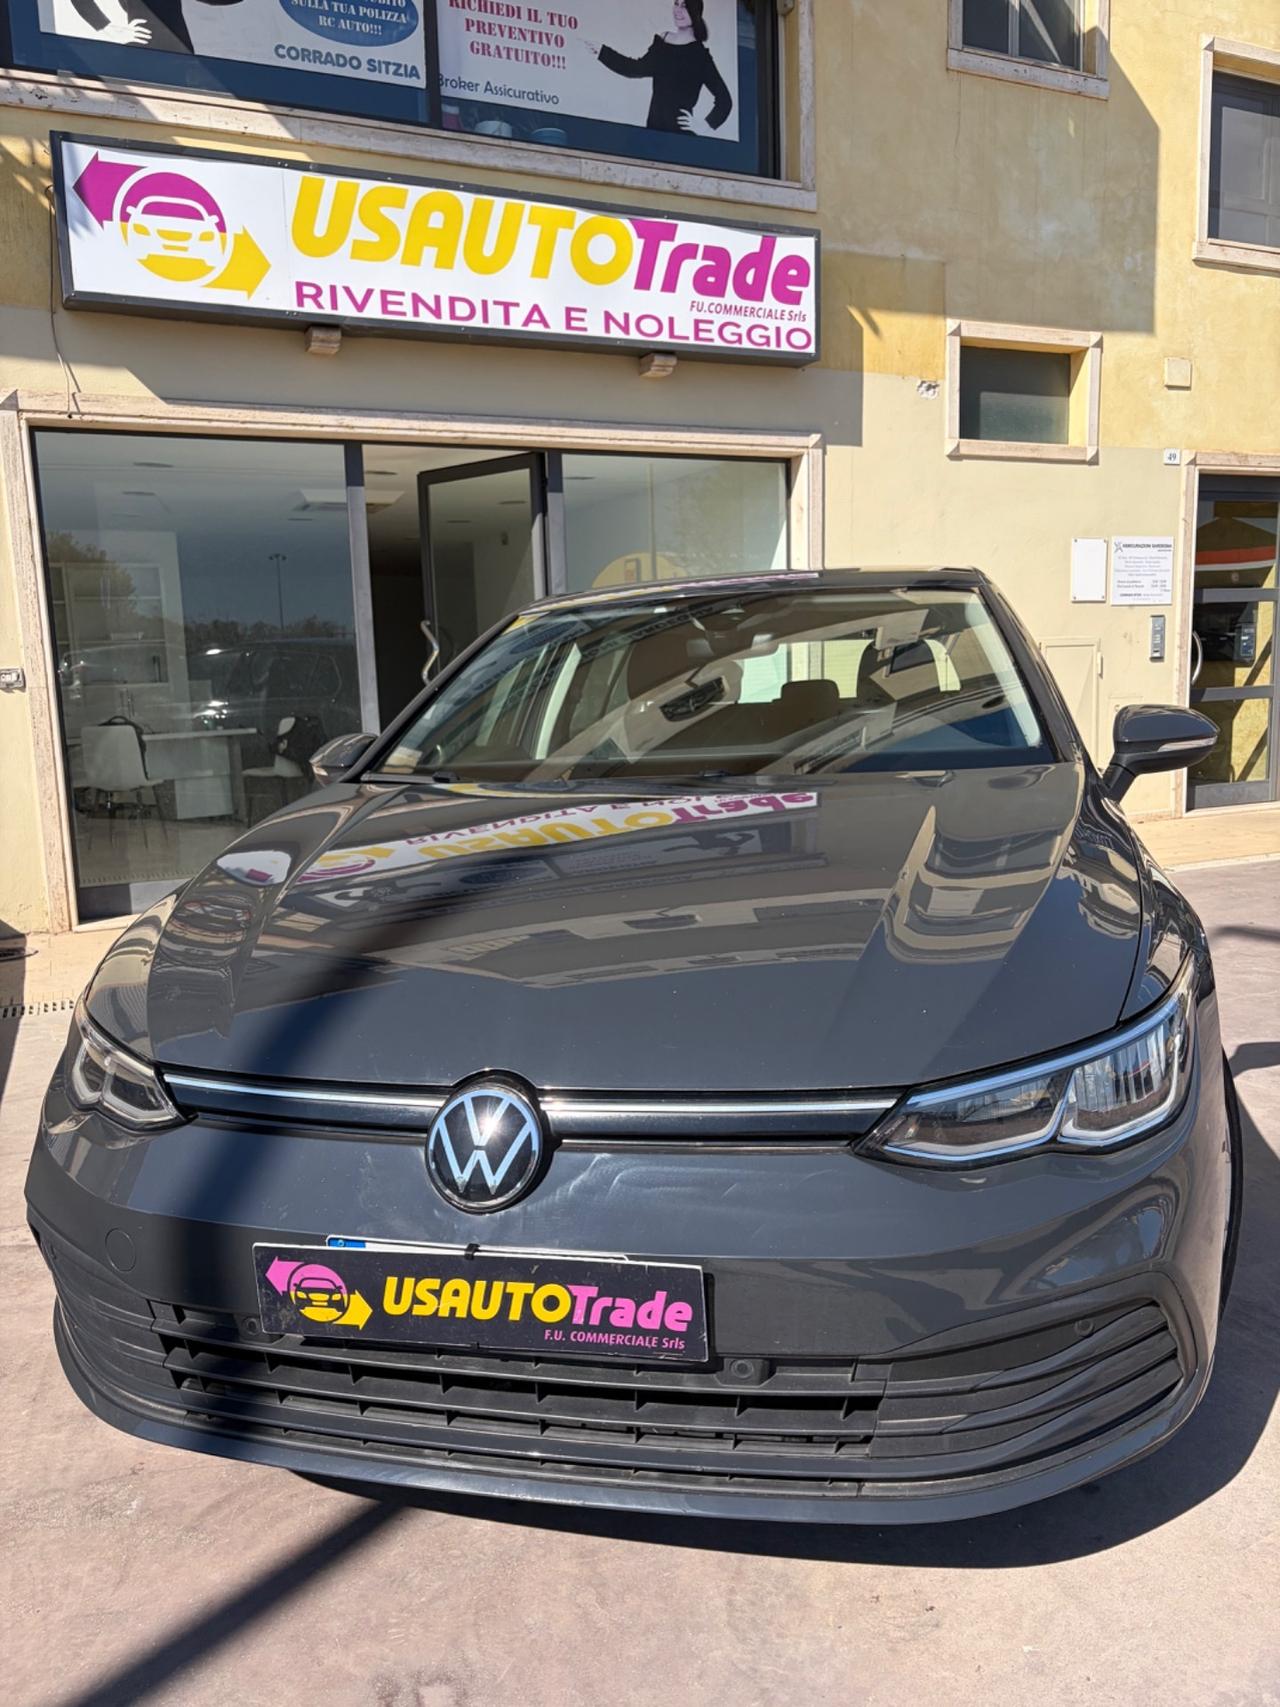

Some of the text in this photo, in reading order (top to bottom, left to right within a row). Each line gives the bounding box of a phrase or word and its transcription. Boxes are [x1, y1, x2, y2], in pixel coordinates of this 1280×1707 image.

[319, 15, 382, 36] RC AUTO!!!
[331, 2, 356, 16] TUA
[359, 6, 407, 24] POLIZZA
[449, 0, 578, 30] RICHIEDI IL TUO
[465, 17, 565, 49] PREVENTIVO
[274, 43, 421, 80] CORRADO SITZIA
[470, 40, 566, 70] GRATUITO!!!
[438, 73, 560, 105] Broker Assicurativo
[291, 175, 811, 306] USAUTOTrade
[295, 280, 812, 351] RIVENDITA E NOLEGGIO
[787, 310, 807, 323] Srls
[383, 1276, 693, 1332] USAUTOTrade
[544, 1330, 686, 1349] F.U. COMMERCIALE Srls
